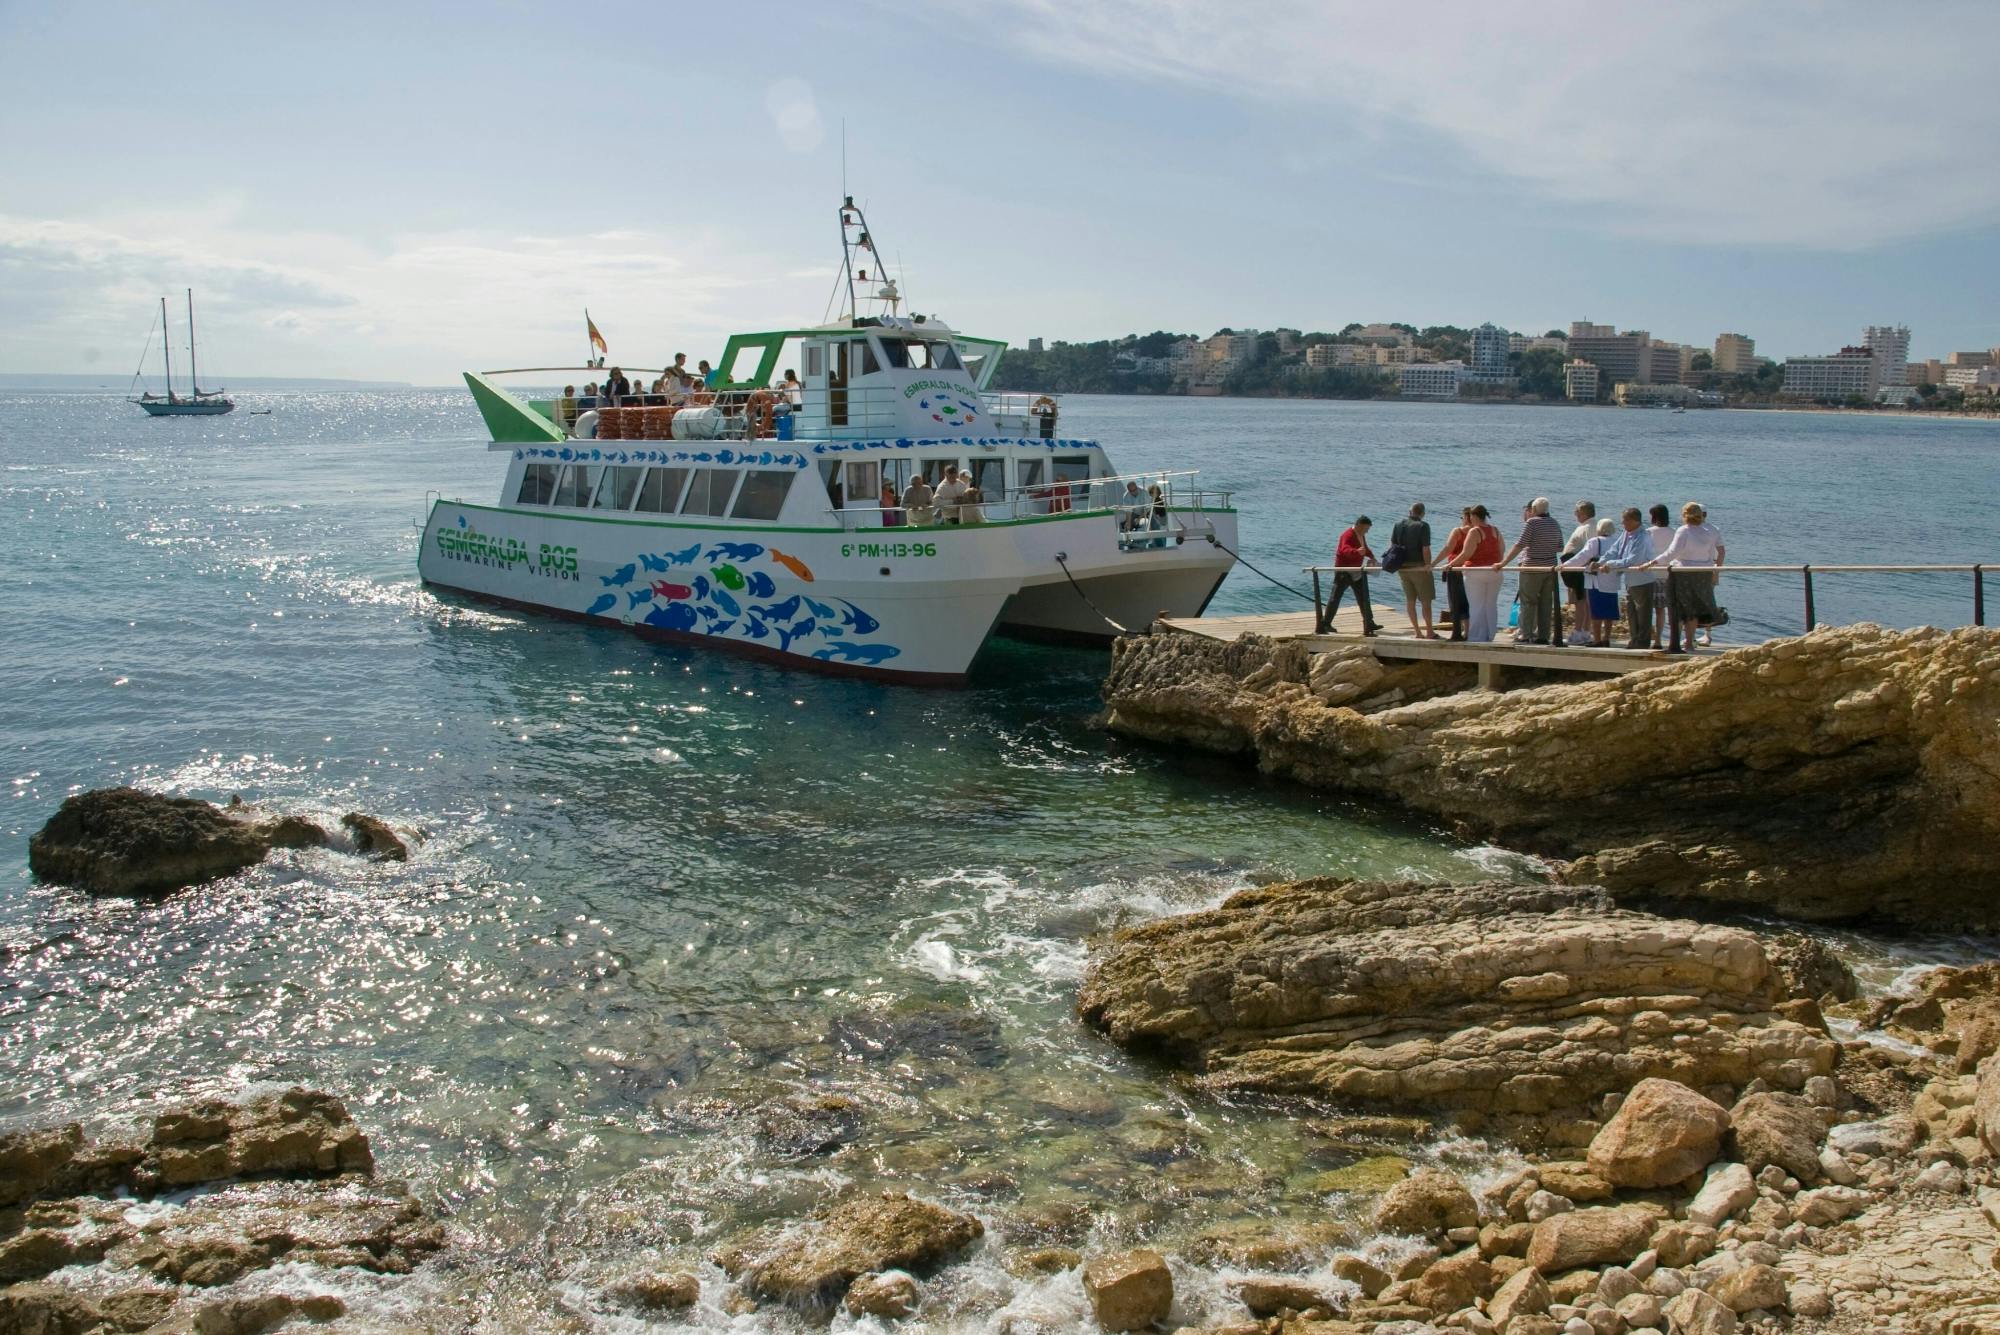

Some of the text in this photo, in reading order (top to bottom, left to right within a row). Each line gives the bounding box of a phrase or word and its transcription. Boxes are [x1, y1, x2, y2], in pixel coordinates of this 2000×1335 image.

[437, 527, 578, 571] ESMERALDA DOS
[440, 550, 580, 582] SUBMARINE VISION
